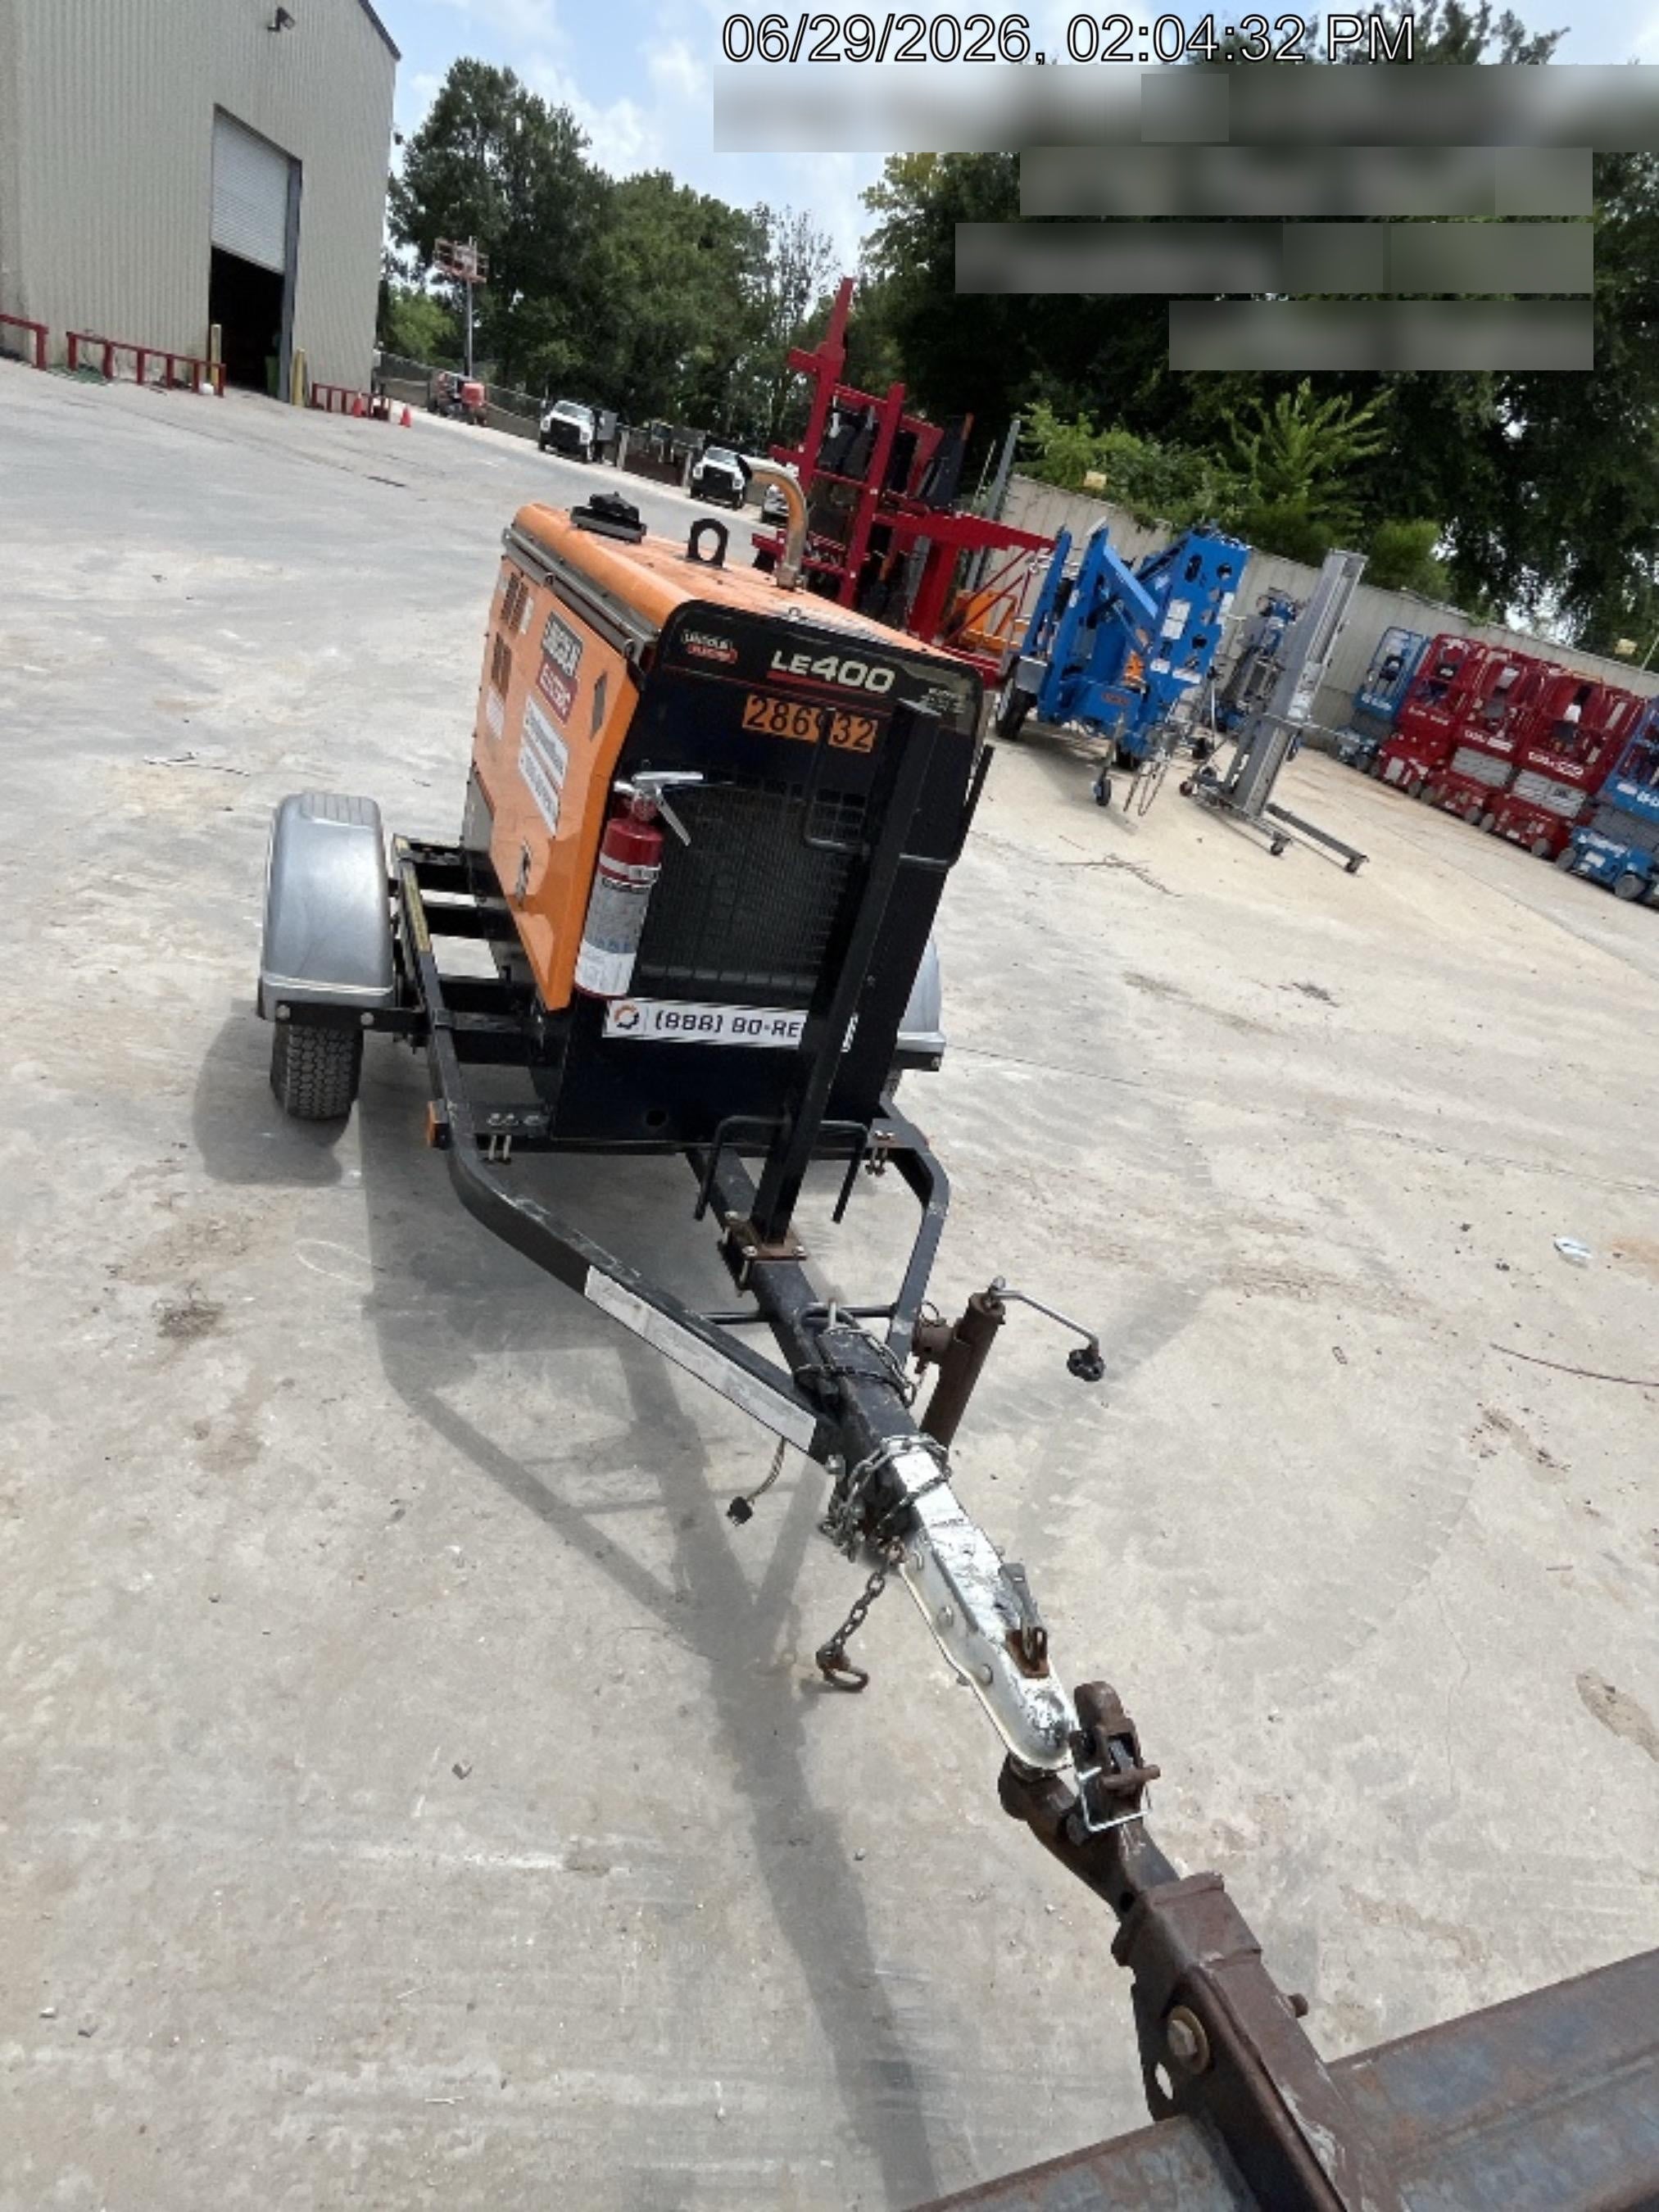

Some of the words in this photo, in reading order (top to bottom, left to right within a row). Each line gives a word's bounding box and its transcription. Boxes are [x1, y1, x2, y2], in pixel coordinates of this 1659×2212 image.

[771, 650, 895, 694] LE400
[746, 696, 874, 749] 28632
[732, 1018, 800, 1038] 80-RE
